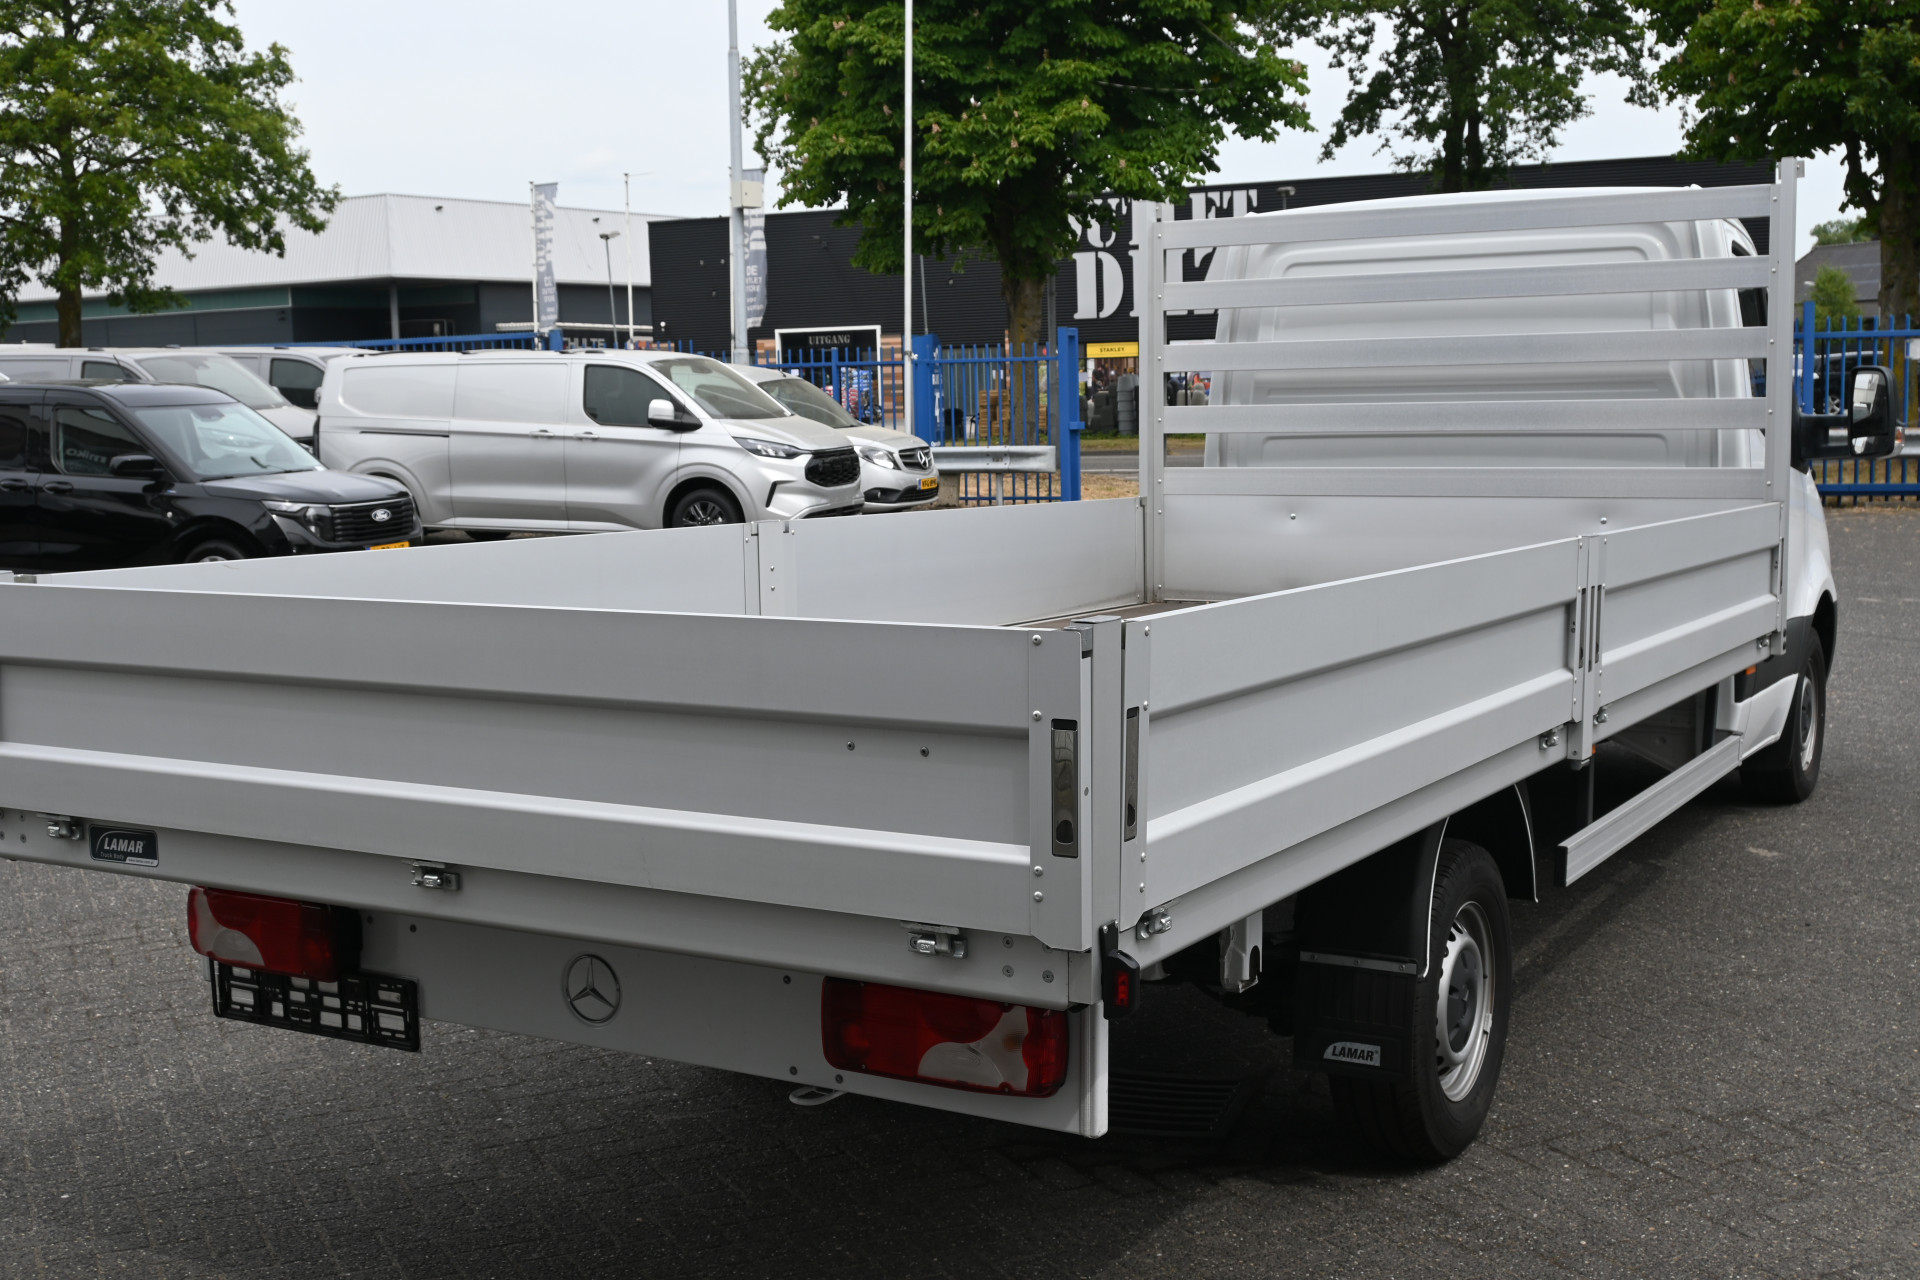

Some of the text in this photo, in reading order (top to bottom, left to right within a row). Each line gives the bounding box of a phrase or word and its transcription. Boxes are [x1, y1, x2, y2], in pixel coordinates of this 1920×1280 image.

[808, 334, 851, 345] UITGANG
[104, 837, 143, 853] LAMAR
[1332, 1046, 1374, 1061] LAMAR
